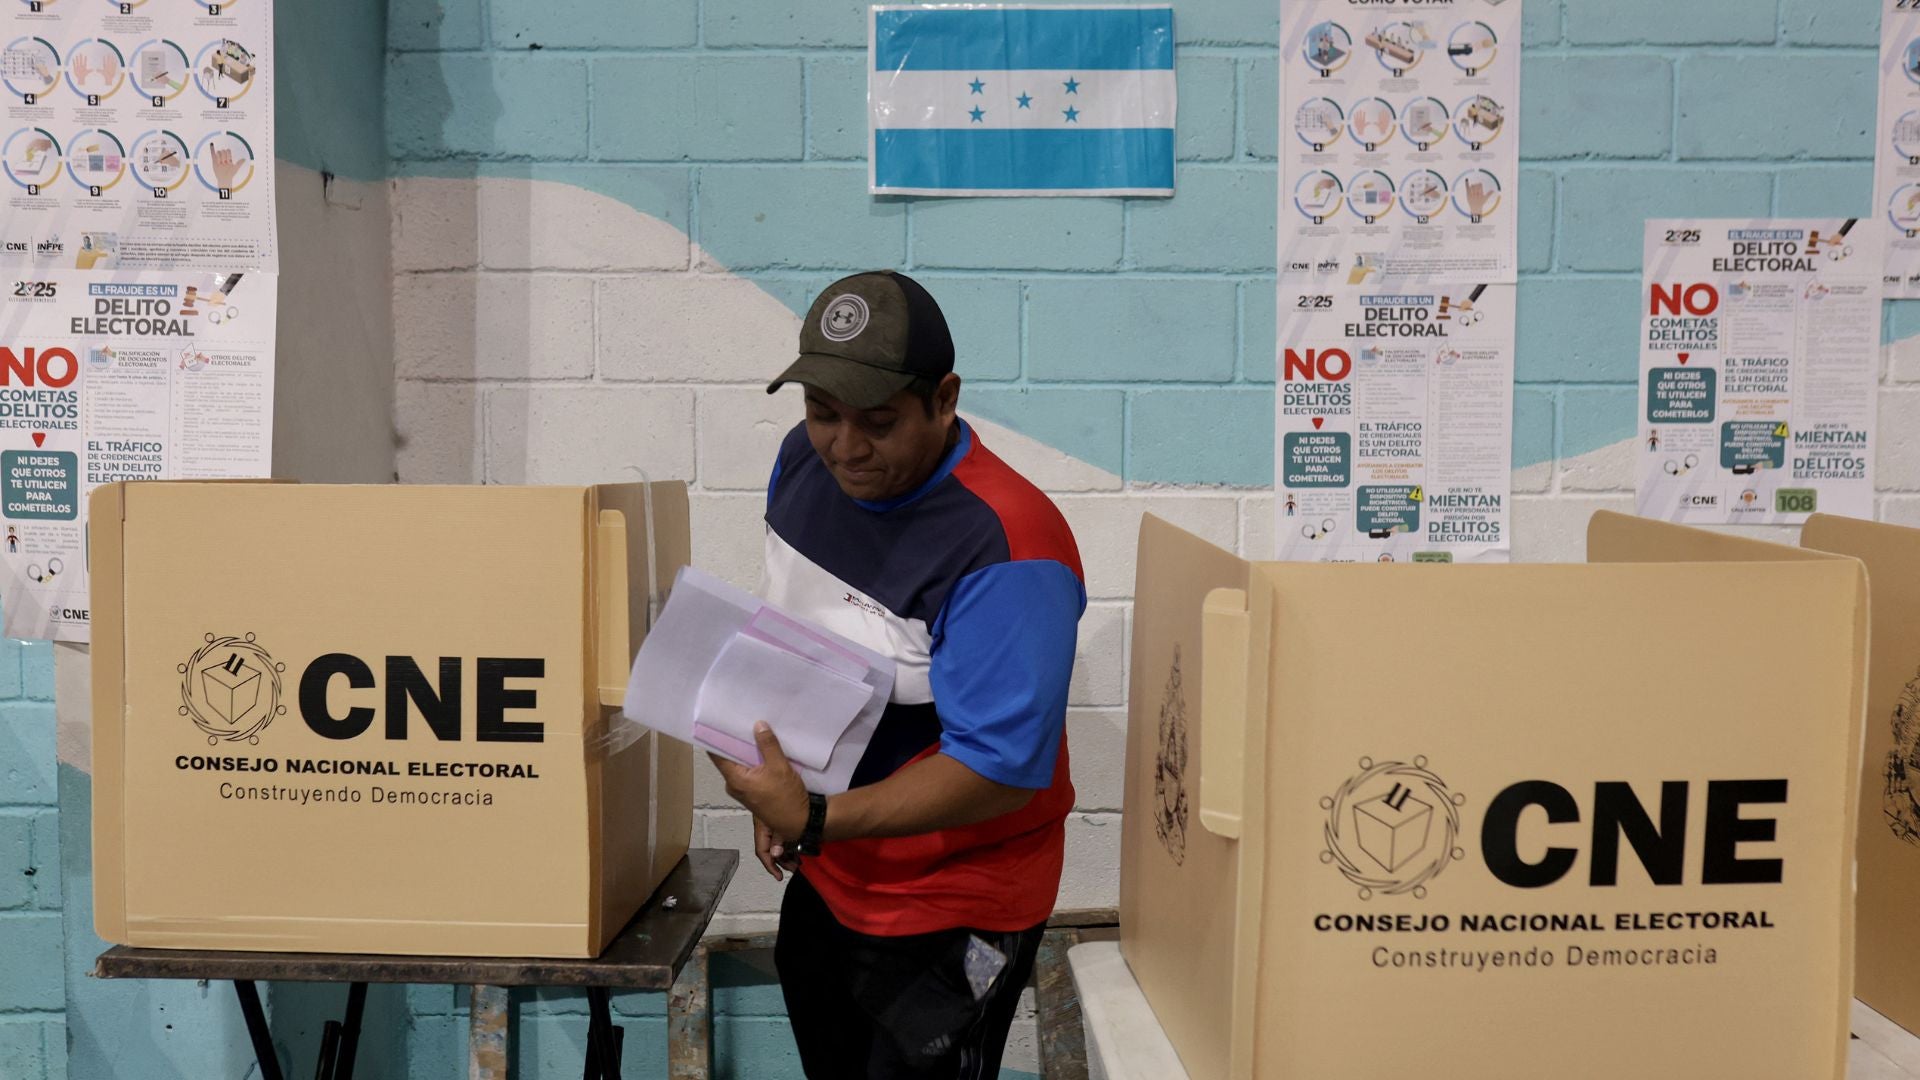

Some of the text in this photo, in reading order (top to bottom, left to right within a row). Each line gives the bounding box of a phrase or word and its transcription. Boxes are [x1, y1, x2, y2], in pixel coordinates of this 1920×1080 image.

[6, 242, 28, 251] CNE
[1733, 242, 1797, 256] DELITO
[1712, 258, 1817, 272] ELECTORAL
[92, 286, 174, 295] EL FRAUDE ES UN
[1650, 283, 1719, 316] NO
[95, 298, 170, 316] DELITO
[1365, 307, 1428, 321] DELITO
[70, 317, 194, 336] ELECTORAL
[1650, 318, 1718, 328] COMETAS
[1345, 323, 1448, 337] ELECTORAL
[1649, 330, 1718, 341] DELITOS
[0, 346, 78, 388] NO
[1284, 348, 1352, 381] NO
[1726, 358, 1789, 366] EL TRÁFICO
[1284, 383, 1351, 393] COMETAS
[0, 390, 78, 403] COMETAS
[1284, 394, 1351, 406] DELITOS
[0, 404, 78, 418] DELITOS
[1284, 407, 1351, 415] ELECTORALES
[0, 420, 78, 430] ELECTORALES
[1359, 422, 1422, 431] EL TRÁFICO
[1795, 431, 1866, 443] MIENTAN
[88, 439, 162, 452] EL TRÁFICO
[1293, 446, 1310, 454] QUE
[1359, 449, 1420, 457] ELECTORAL
[30, 457, 59, 466] DEJES
[88, 462, 162, 472] ES UN DELITO
[1794, 458, 1865, 469] DELITOS
[12, 468, 66, 478] QUE OTROS
[25, 480, 66, 489] UTILICEN
[26, 492, 52, 501] PARA
[1429, 495, 1501, 506] MIENTAN
[1692, 496, 1717, 505] CNE
[8, 503, 70, 513] COMETERLOS
[1780, 495, 1813, 511] 108
[1429, 521, 1500, 533] DELITOS
[63, 609, 90, 620] CNE
[298, 653, 545, 742] CNE
[175, 755, 539, 778] CONSEJO NACIONAL ELECTORAL
[220, 782, 493, 806] Construyendo Democracia
[1481, 779, 1788, 888] CNE
[1314, 911, 1774, 933] CONSEJO NACIONAL ELECTORAL
[1372, 944, 1717, 972] Construyendo Democracia
